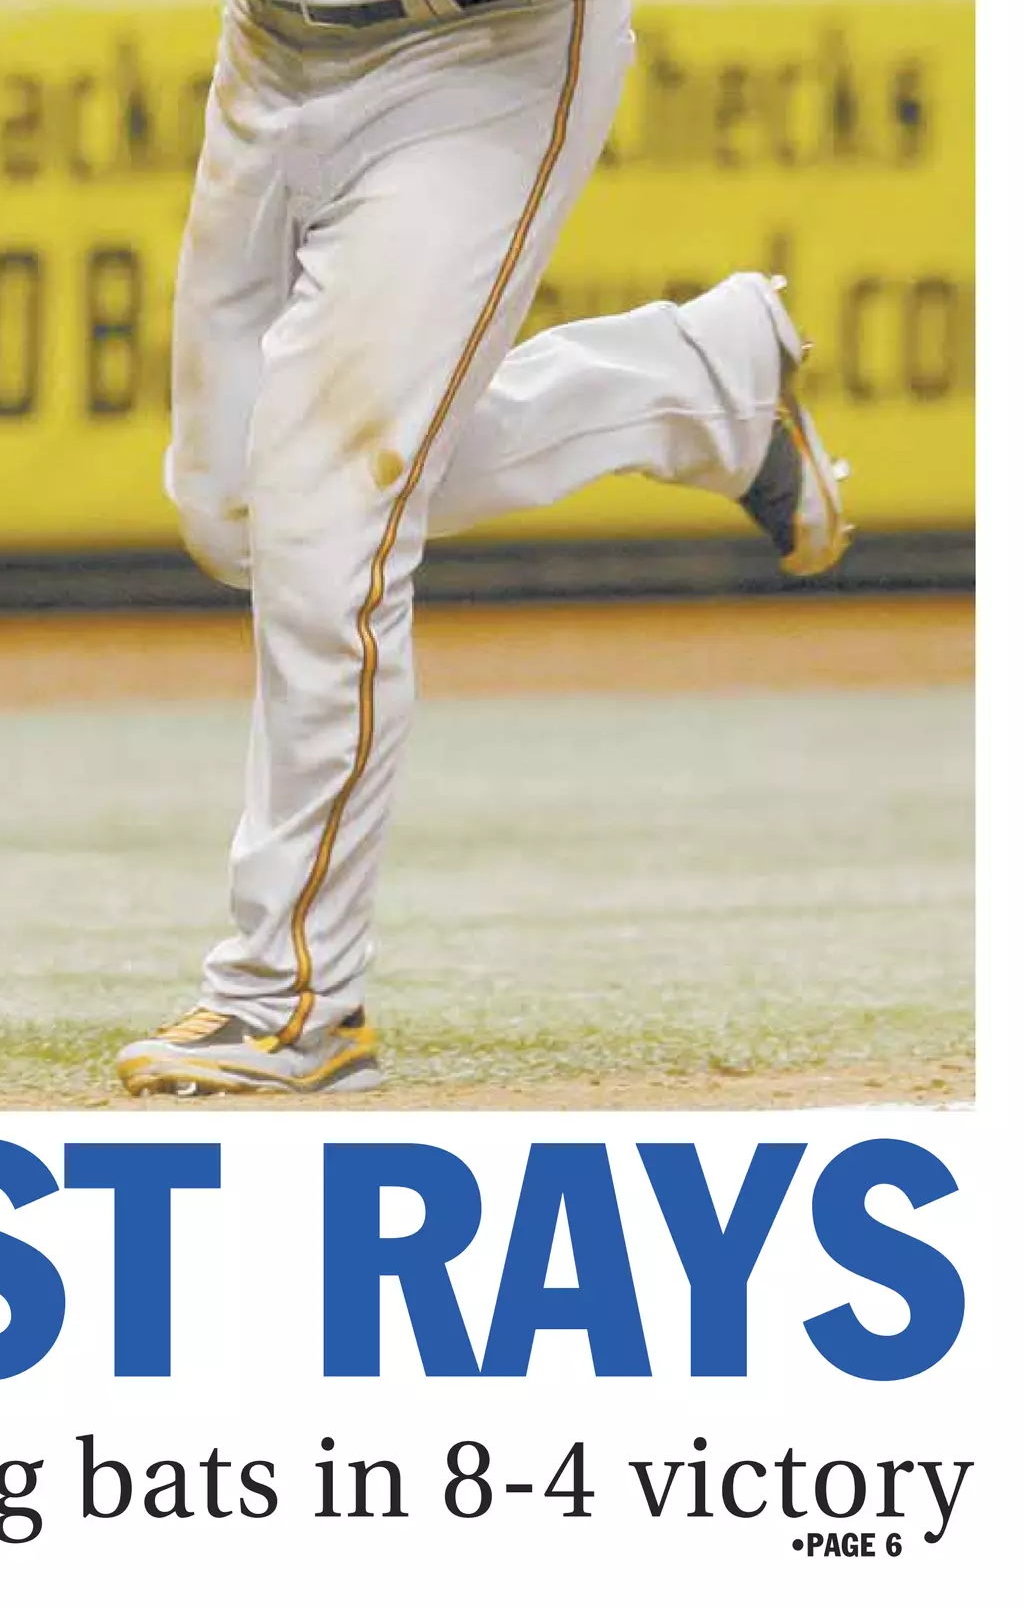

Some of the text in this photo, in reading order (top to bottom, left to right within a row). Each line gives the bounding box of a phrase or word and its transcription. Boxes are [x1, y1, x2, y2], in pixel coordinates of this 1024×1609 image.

[323, 1138, 965, 1382] RAYS
[75, 1433, 278, 1519] bats
[314, 1436, 409, 1517] in
[444, 1440, 595, 1519] 8-4
[628, 1436, 975, 1544] victory
[885, 1532, 903, 1558] 6
